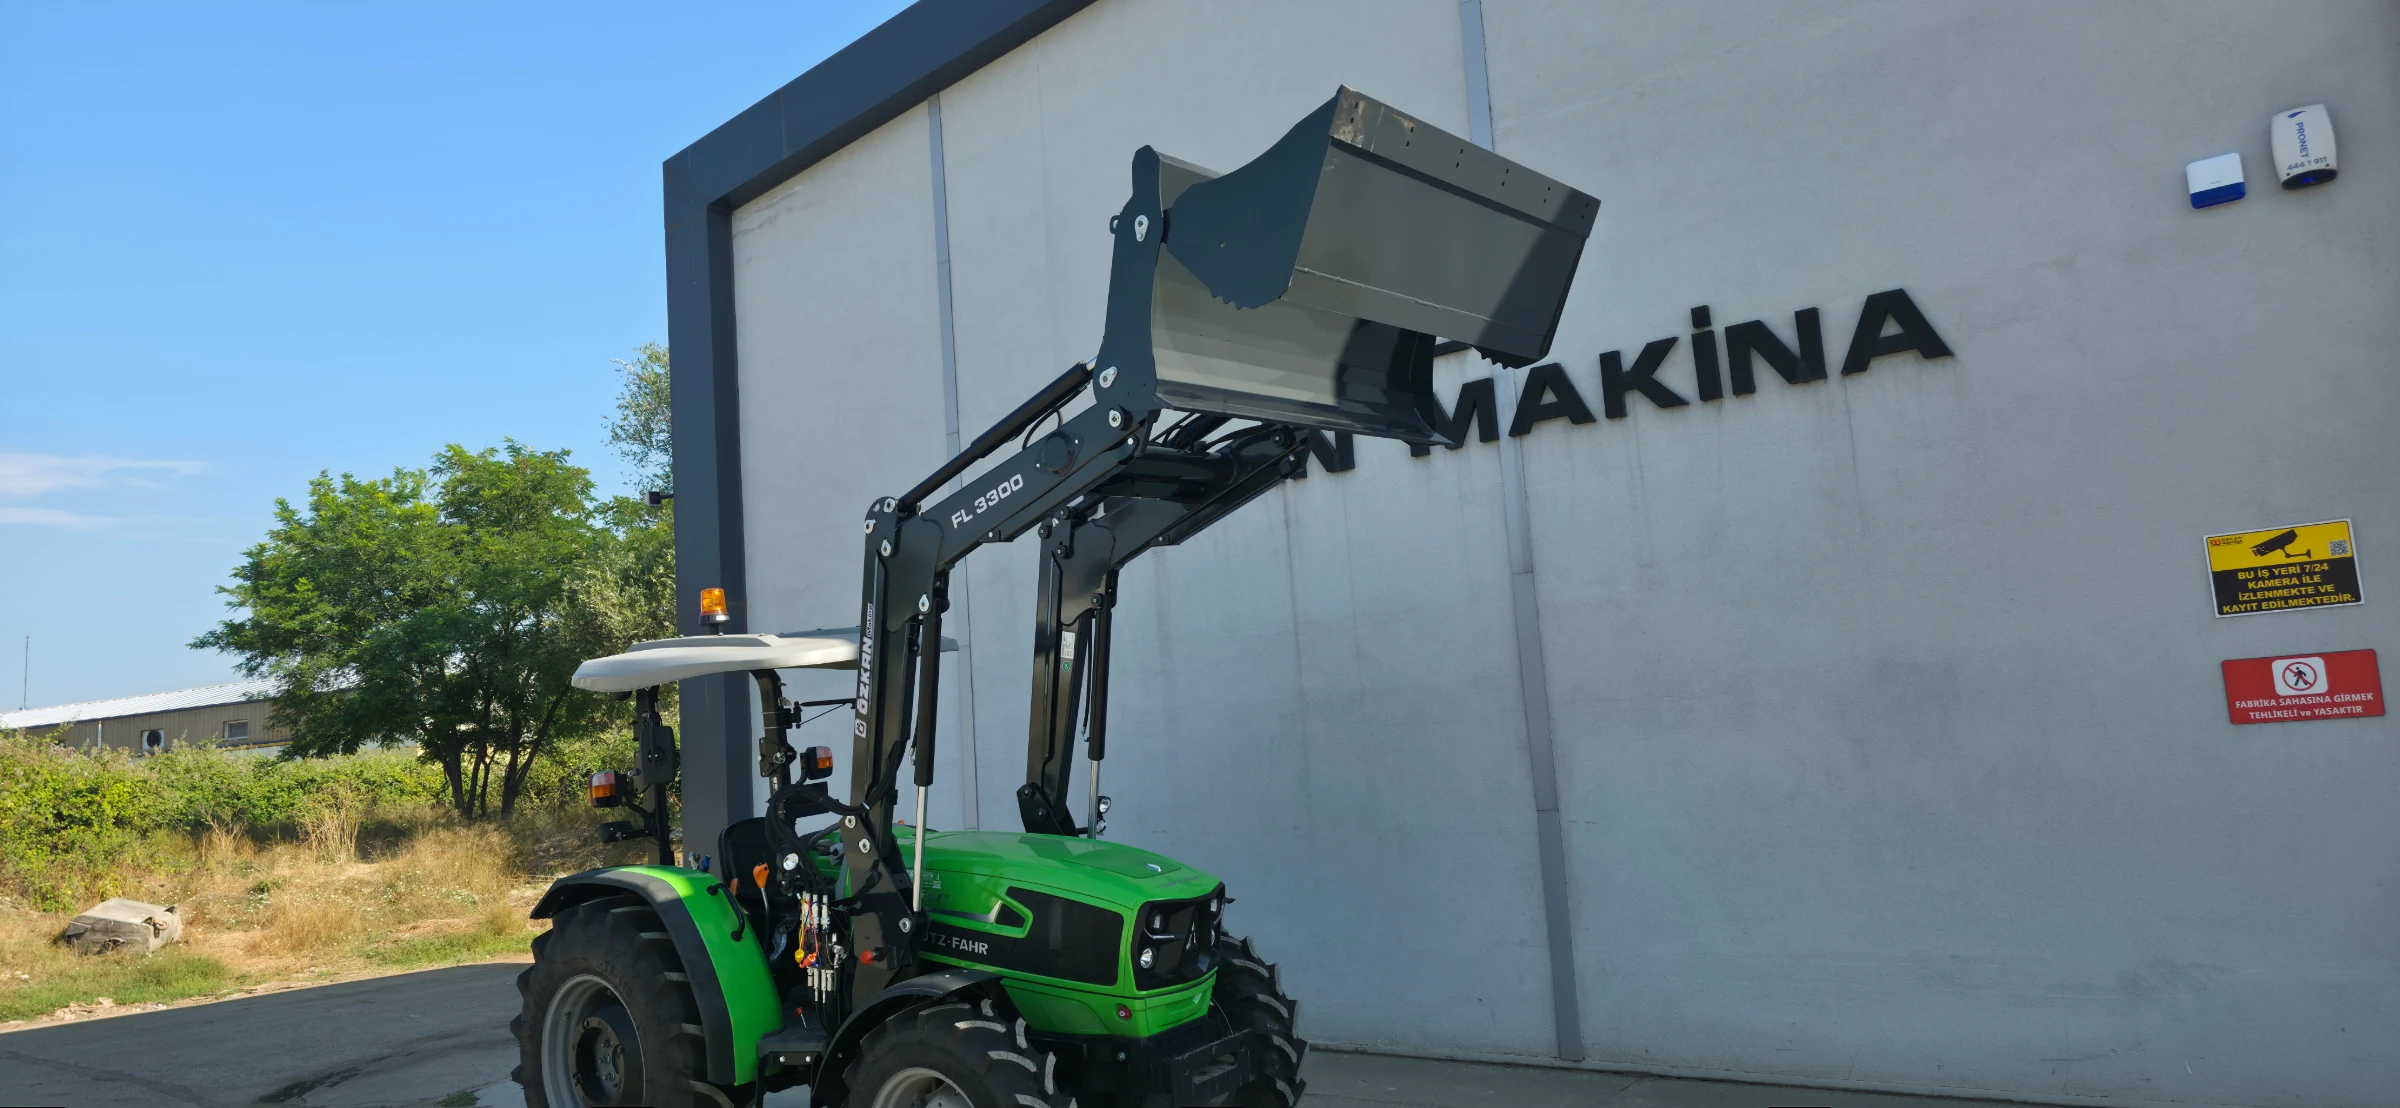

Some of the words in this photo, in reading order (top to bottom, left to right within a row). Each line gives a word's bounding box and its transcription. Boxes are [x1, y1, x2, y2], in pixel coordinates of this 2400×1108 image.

[2295, 122, 2309, 157] PRONET
[2287, 162, 2305, 170] 444
[1410, 288, 1955, 457] MAKİNA
[951, 509, 973, 529] FL
[974, 473, 1024, 514] 3300
[2237, 571, 2254, 579] BU
[2257, 568, 2270, 578] İŞ
[2272, 564, 2301, 576] YERİ
[2303, 562, 2329, 573] 7/24
[2247, 577, 2300, 589] KAMERA
[2302, 574, 2322, 584] İLE
[2238, 587, 2316, 601] İZLENMEKTE
[2318, 584, 2335, 593] VE
[2222, 603, 2258, 613] KAYIT
[2261, 593, 2356, 610] EDİLMEKTEDİR.
[857, 636, 873, 715] ÖZKAN
[2235, 698, 2277, 709] FABRİKA
[2279, 695, 2331, 706] SAHASINA
[2333, 692, 2374, 702] GİRMEK
[2249, 708, 2298, 720] TEHLİKELİ
[2300, 709, 2312, 717] ve
[2313, 705, 2363, 716] YASAKTIR
[923, 932, 989, 955] UTZ-FAHR
